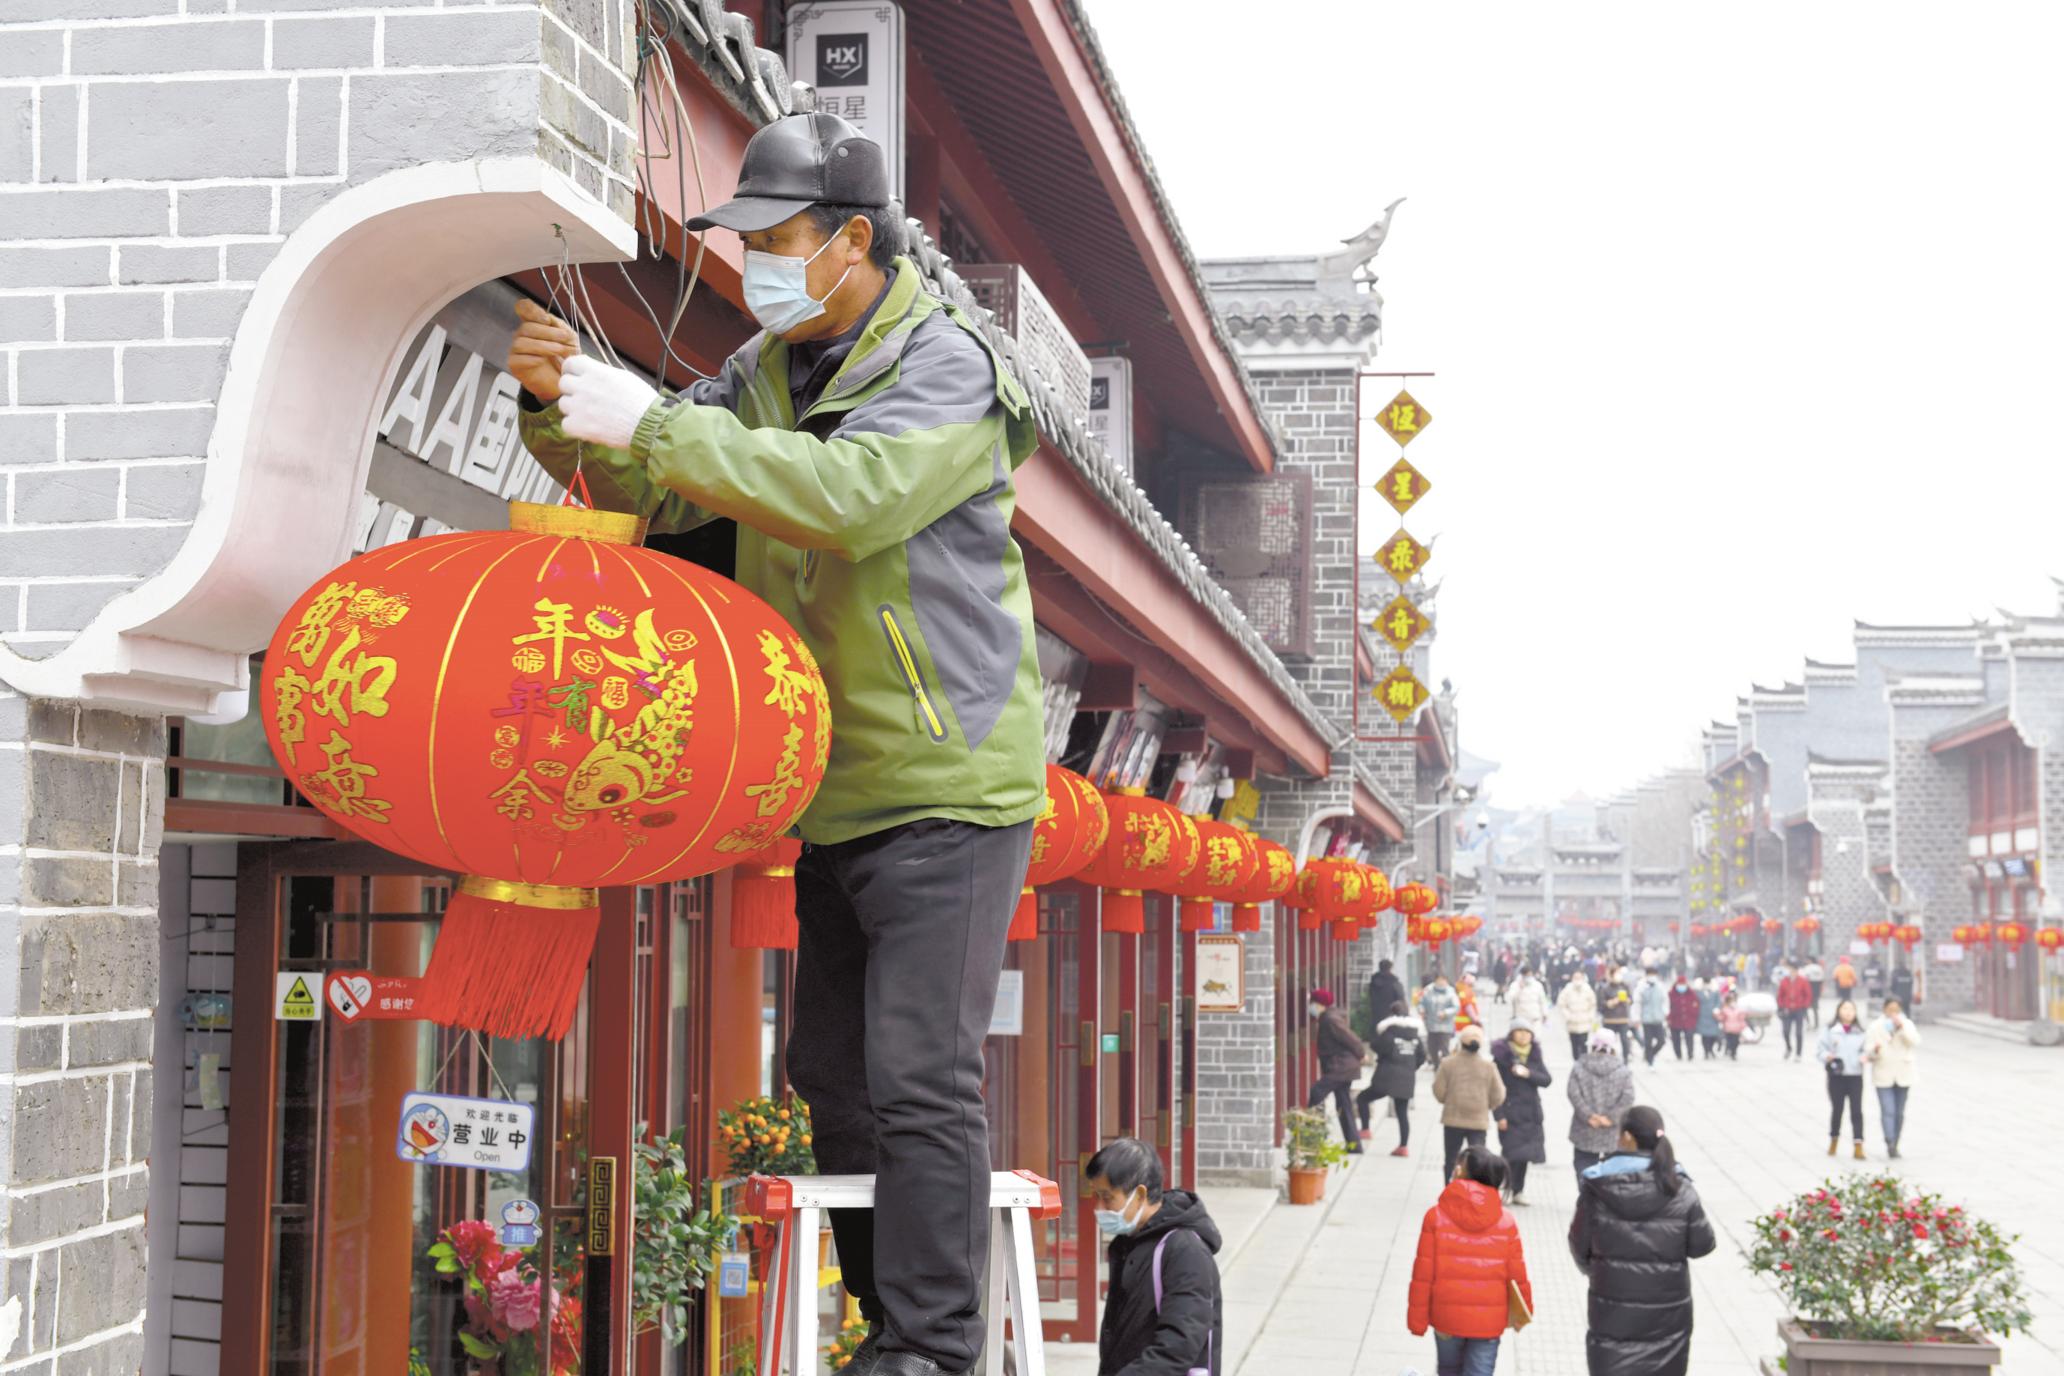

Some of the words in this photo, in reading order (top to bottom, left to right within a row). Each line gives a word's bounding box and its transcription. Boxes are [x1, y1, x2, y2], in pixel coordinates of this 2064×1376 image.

[826, 47, 857, 64] HX
[465, 1108, 519, 1124] 欢迎光临
[453, 1123, 527, 1150] 营业中
[474, 1150, 501, 1163] Open
